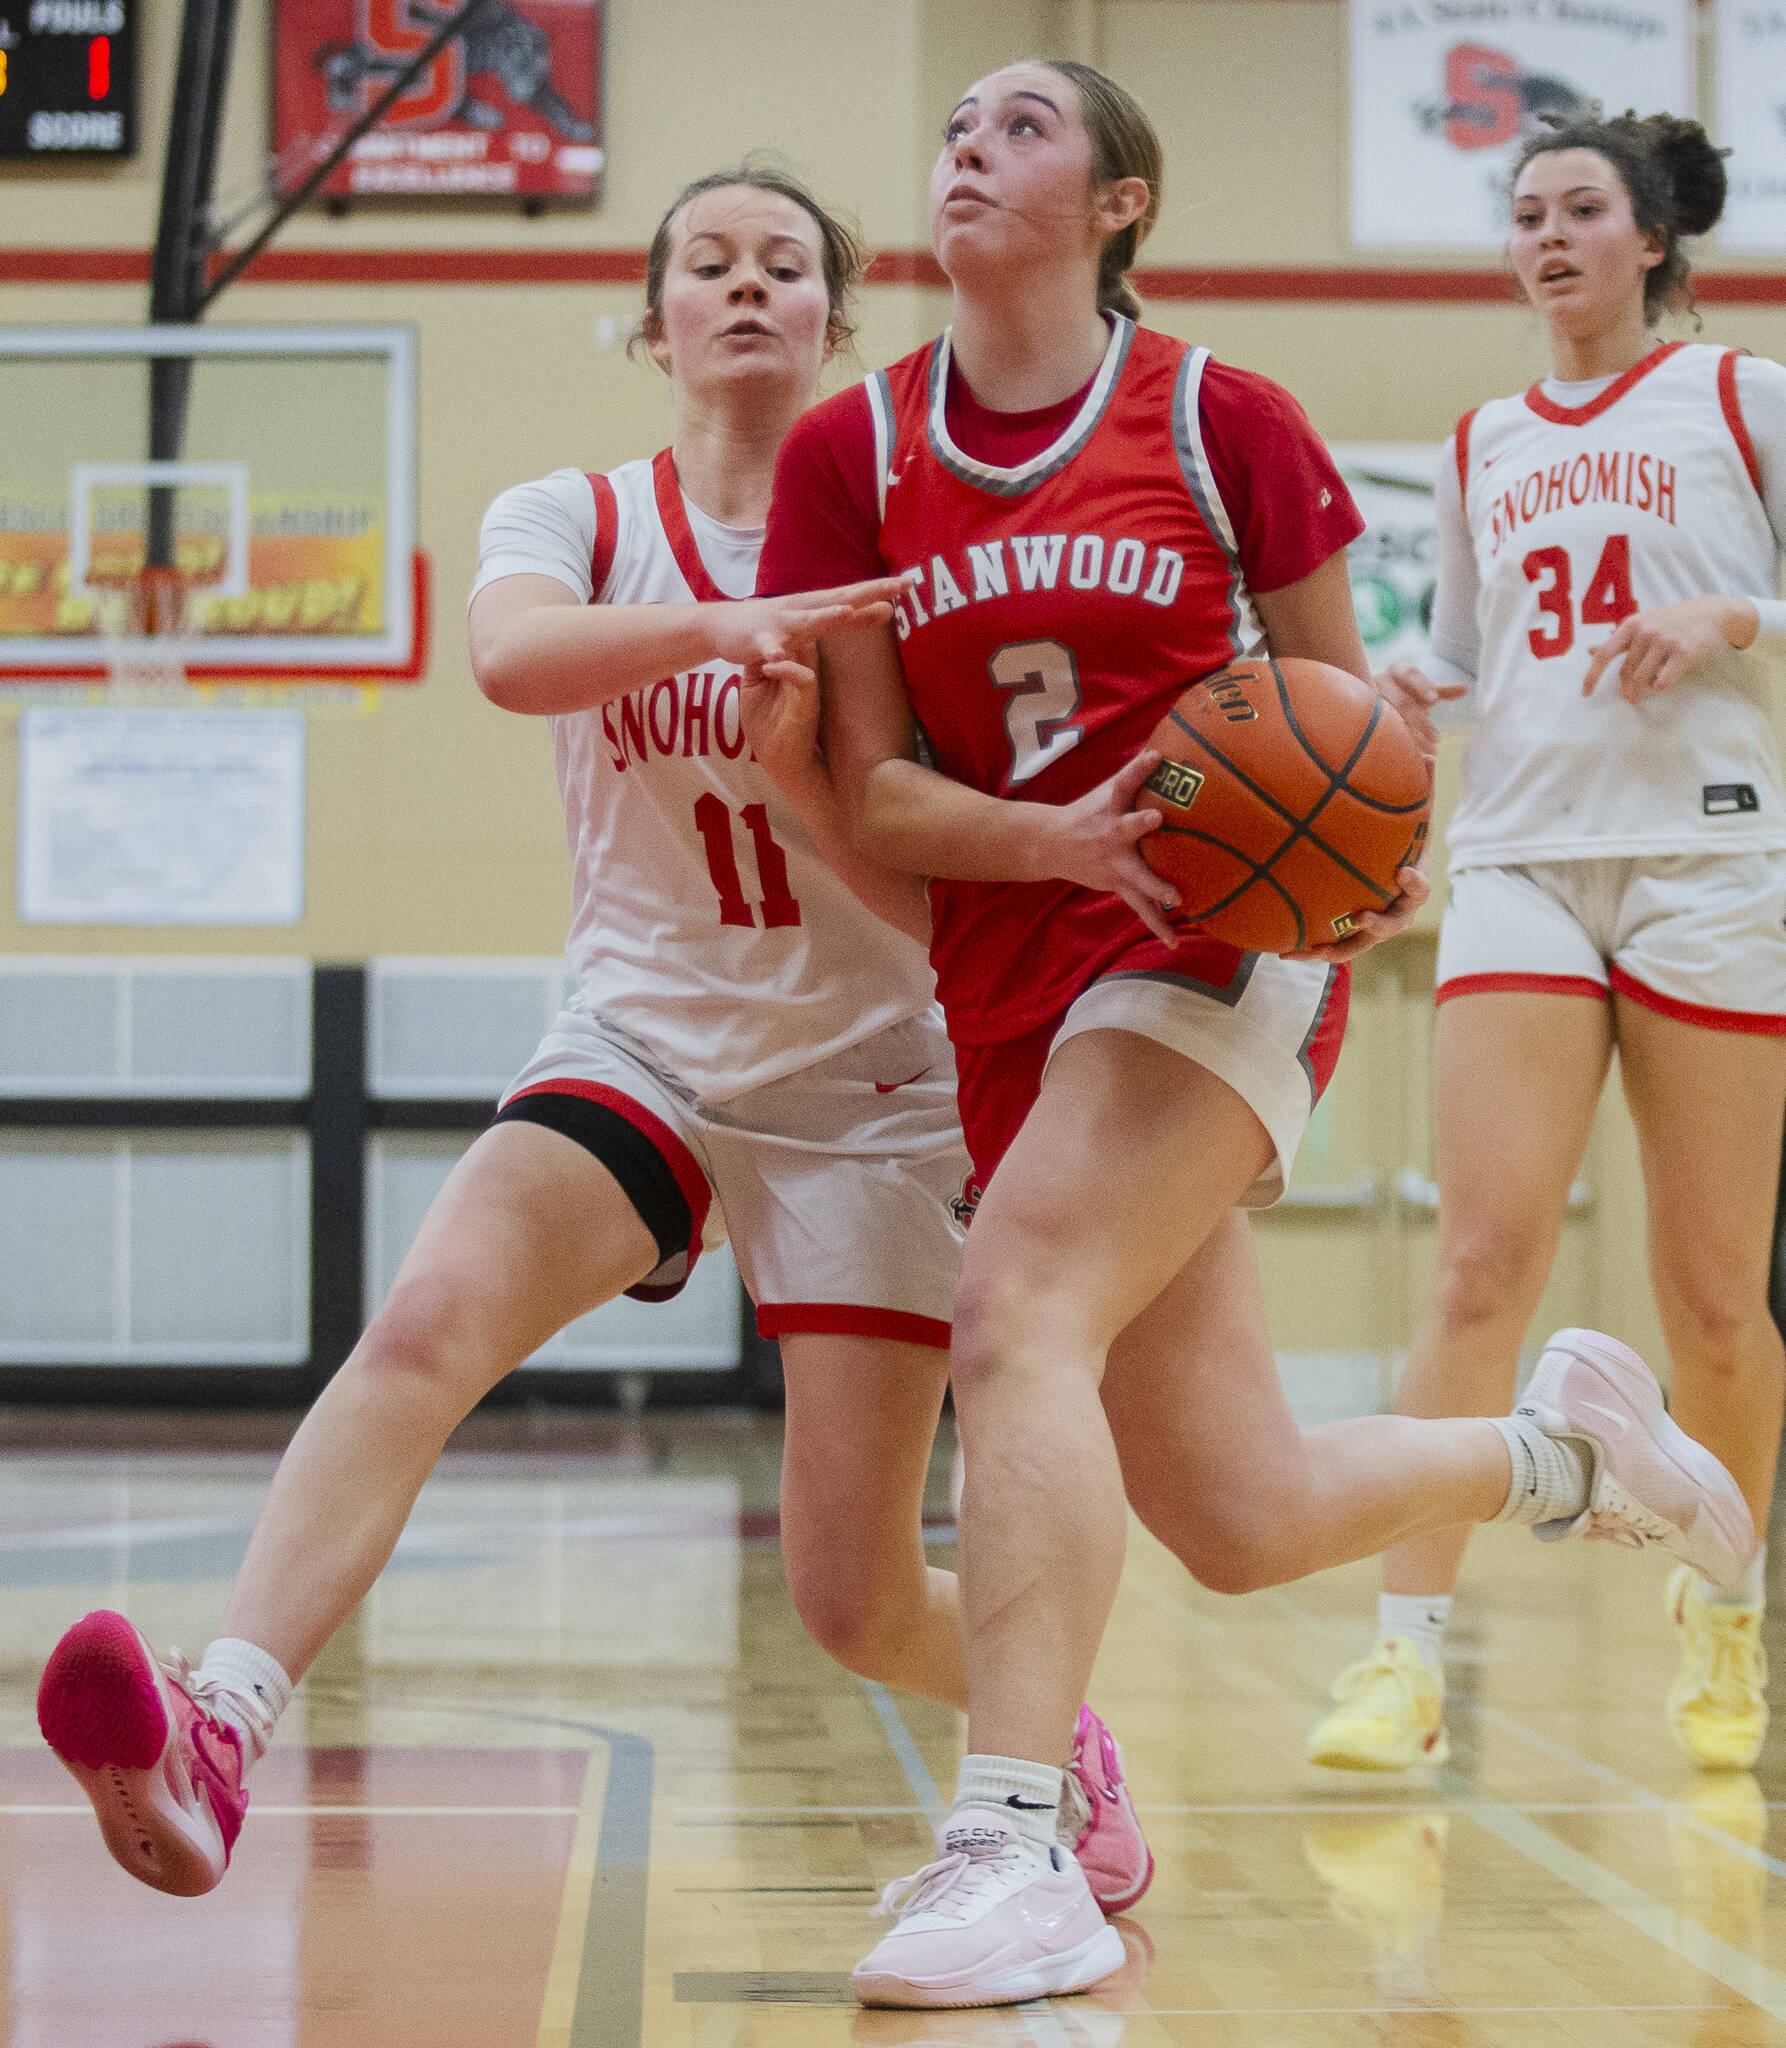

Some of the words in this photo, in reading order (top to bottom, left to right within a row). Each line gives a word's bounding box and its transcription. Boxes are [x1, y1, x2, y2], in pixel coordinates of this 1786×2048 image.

[88, 35, 110, 101] 1
[27, 111, 124, 149] SCORE
[1492, 451, 1676, 557] SNOHOMISH
[1521, 533, 1640, 660] 34
[986, 636, 1084, 787] 2
[694, 791, 801, 929] 11
